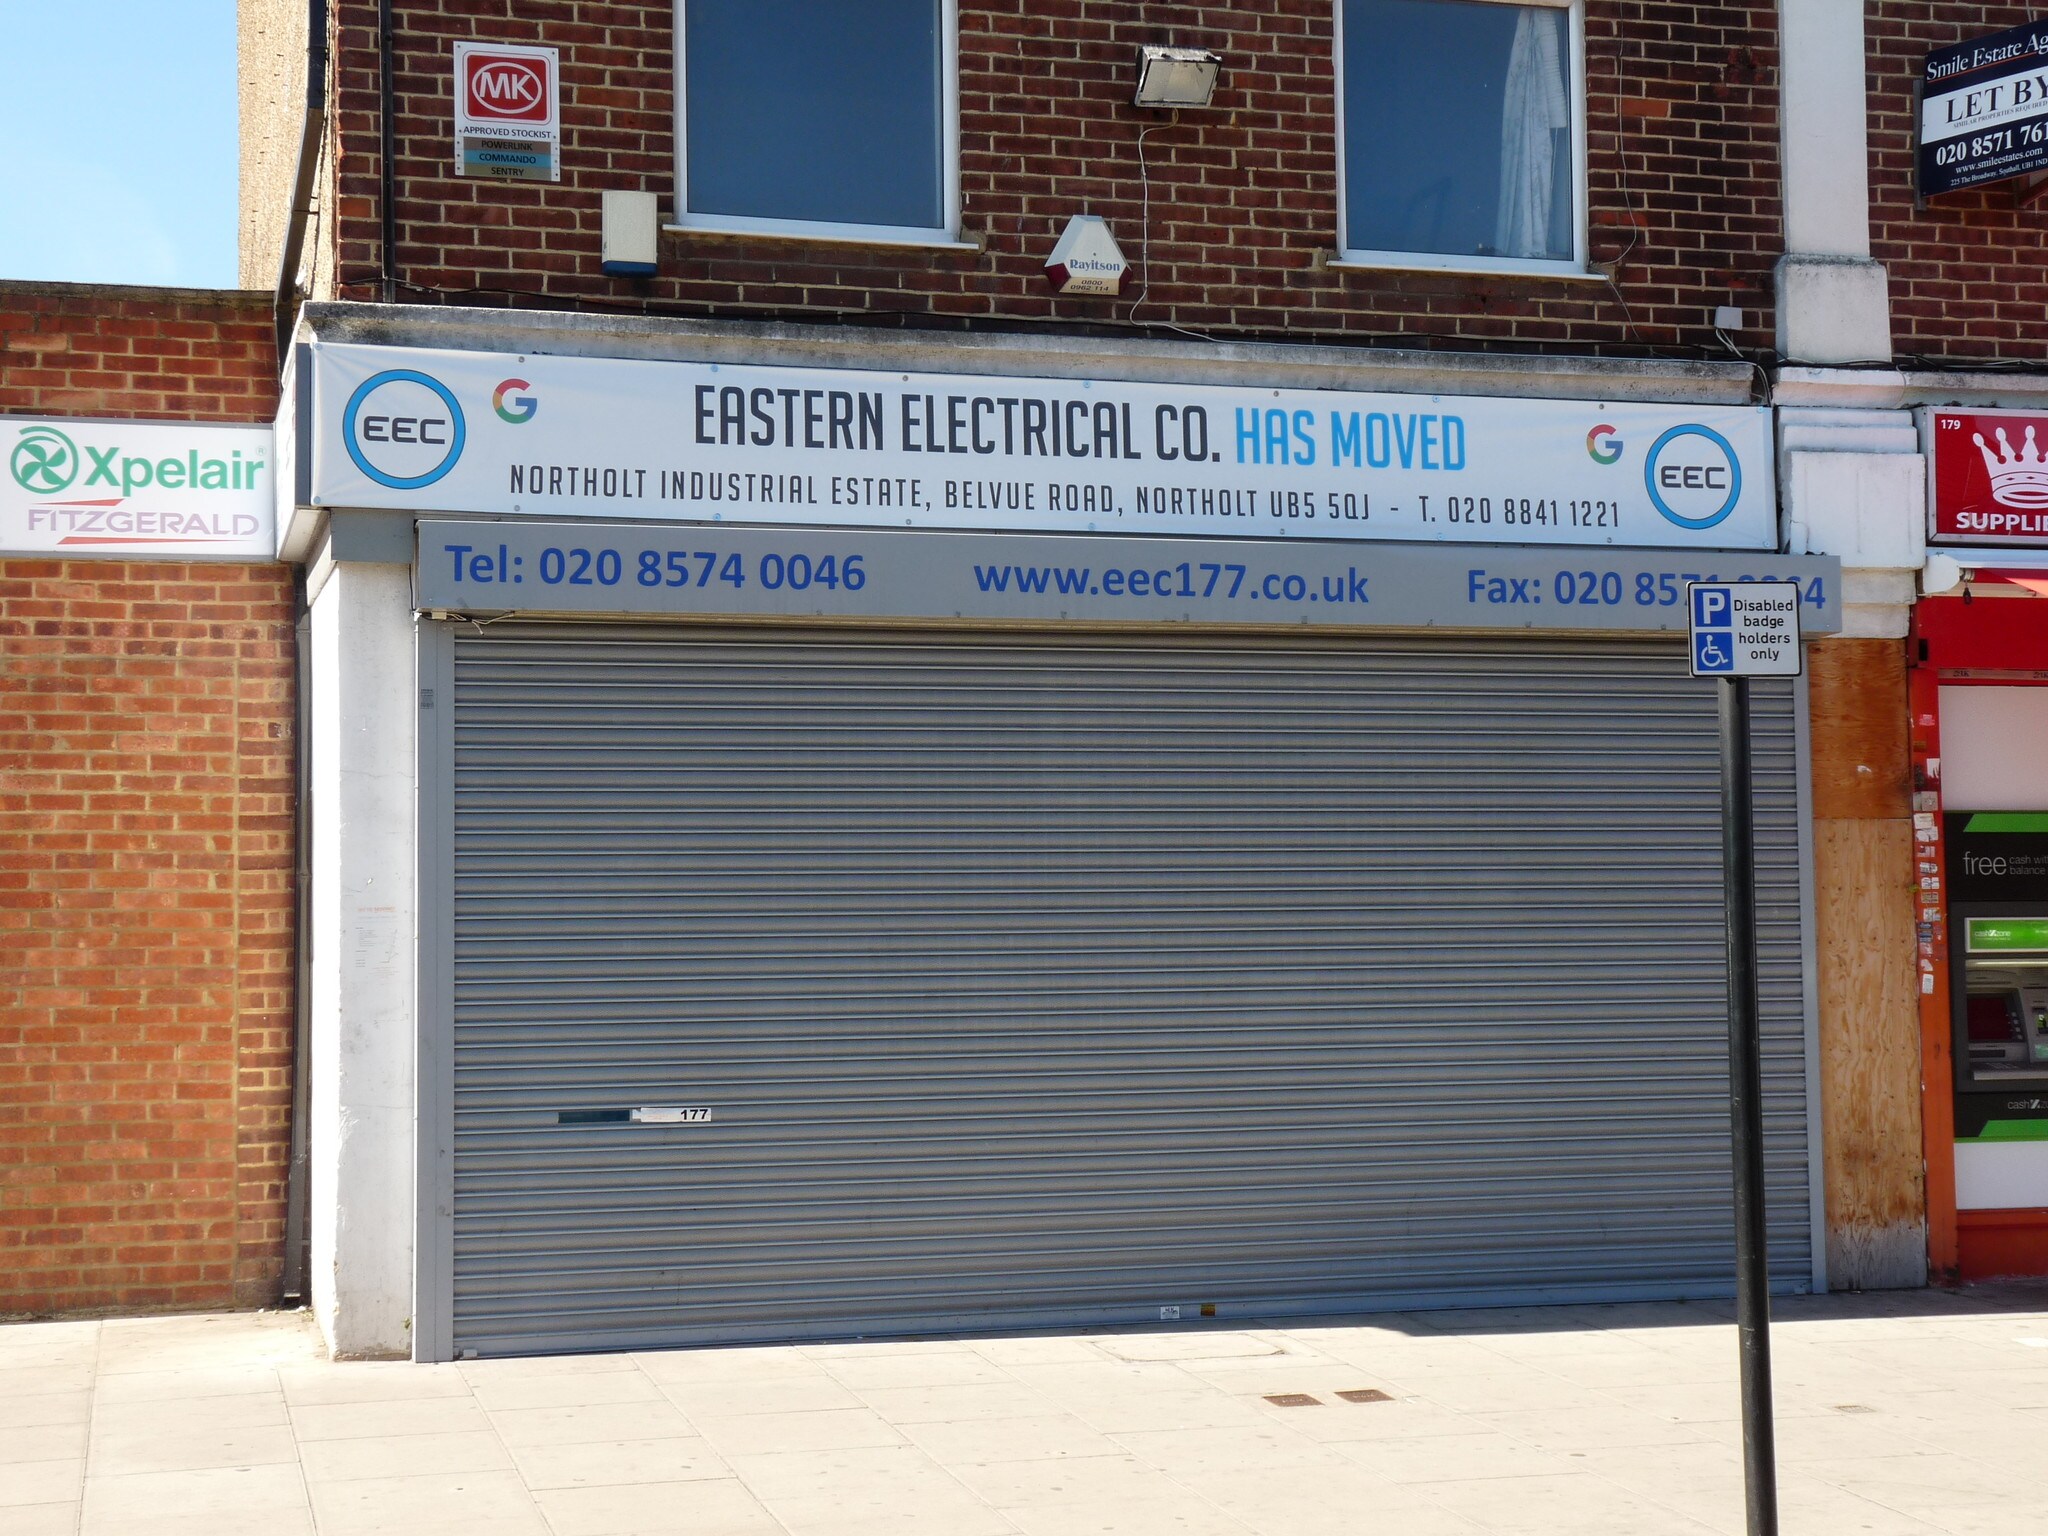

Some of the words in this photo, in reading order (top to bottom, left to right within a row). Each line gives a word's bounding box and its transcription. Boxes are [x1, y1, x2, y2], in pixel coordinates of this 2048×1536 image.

[1926, 54, 1969, 81] Smile
[1972, 42, 2022, 68] Estate
[2024, 33, 2048, 55] Ag
[479, 72, 535, 101] MK
[1945, 85, 2004, 124] LET
[2012, 75, 2048, 106] BY
[1977, 107, 2014, 122] PROPERTIES
[2014, 100, 2048, 113] REQUIRED
[463, 126, 510, 136] APPROVED
[511, 129, 552, 139] STOCKIST
[481, 140, 533, 151] POWERLINK
[1936, 141, 1967, 167] 020
[1971, 129, 2013, 158] 8571
[478, 153, 537, 164] COMMANDO
[491, 166, 524, 176] SENTRY
[1955, 147, 2043, 175] www.smileestates.com
[1961, 175, 1971, 184] The
[1070, 259, 1120, 271] Rayitson
[363, 415, 446, 445] EEC
[695, 384, 884, 451] EASTERN
[901, 393, 1142, 461] ELECTRICAL
[1154, 404, 1221, 463] CO.
[1235, 407, 1316, 466] HAS
[1330, 411, 1466, 471] MOVED
[1940, 419, 1961, 430] 179
[84, 446, 265, 497] Xpelair
[1660, 465, 1726, 490] EEC
[510, 464, 646, 498] NORTHOLT
[661, 470, 818, 504] INDUSTRIAL
[831, 476, 932, 512] ESTATE,
[945, 480, 1035, 511] BELVUE
[1049, 483, 1123, 518] ROAD,
[1136, 486, 1257, 517] NORTHOLT
[1270, 491, 1315, 519] UB5
[1328, 493, 1370, 521] 5QJ
[1418, 495, 1436, 522] T.
[1448, 496, 1491, 524] 020
[1504, 498, 1558, 526] 8841
[1569, 500, 1619, 528] 1221
[28, 509, 259, 536] FITZGERALD
[444, 545, 523, 583] Tel:
[540, 547, 622, 586] 020
[637, 550, 746, 588] 8574
[759, 554, 866, 590] 0046
[974, 562, 1369, 603] www.eec177.co.uk
[1468, 569, 1541, 604] Fax:
[1554, 570, 1623, 605] 020
[1634, 572, 1719, 606] 85
[1702, 592, 1725, 624] P
[1733, 600, 1794, 611] Disabled
[1743, 615, 1785, 629] badge
[1738, 632, 1791, 644] holders
[1750, 648, 1780, 661] only
[1962, 851, 2007, 876] free
[2009, 854, 2032, 865] cash
[2009, 865, 2046, 875] balance
[680, 1109, 708, 1120] 177
